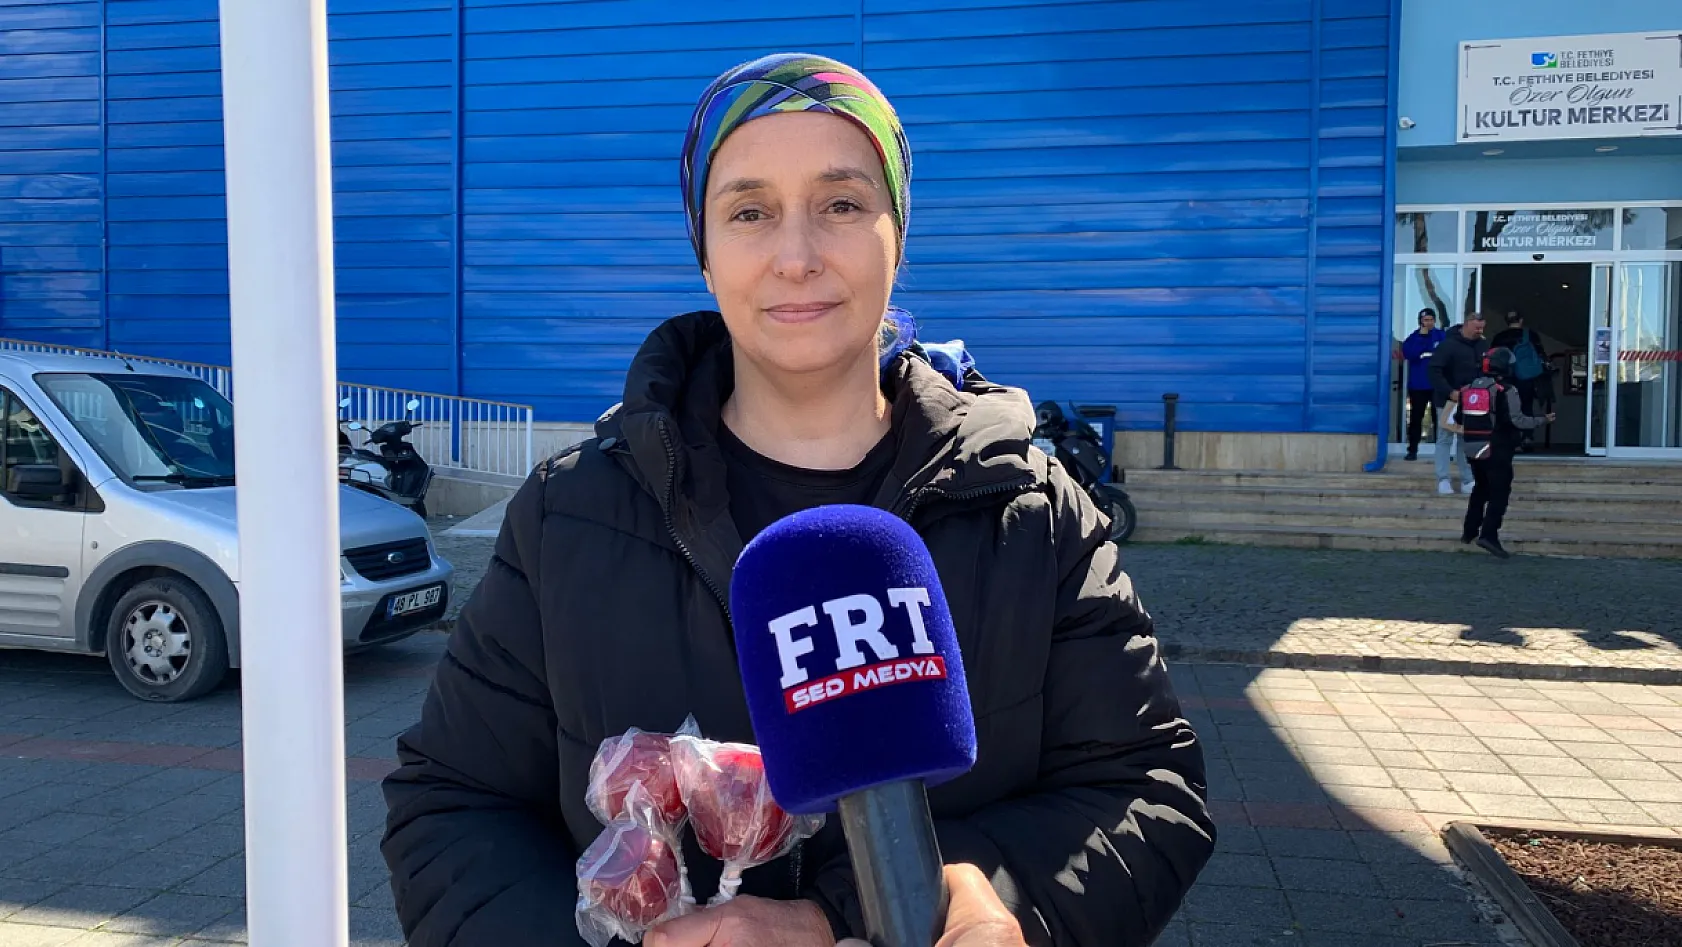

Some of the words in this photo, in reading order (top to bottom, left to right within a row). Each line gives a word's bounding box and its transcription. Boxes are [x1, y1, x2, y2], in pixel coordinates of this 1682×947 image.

[1492, 76, 1515, 86] T.C.
[408, 593, 420, 607] PL
[768, 587, 936, 690] FRT
[792, 678, 845, 709] SED
[853, 660, 941, 690] MEDYA
